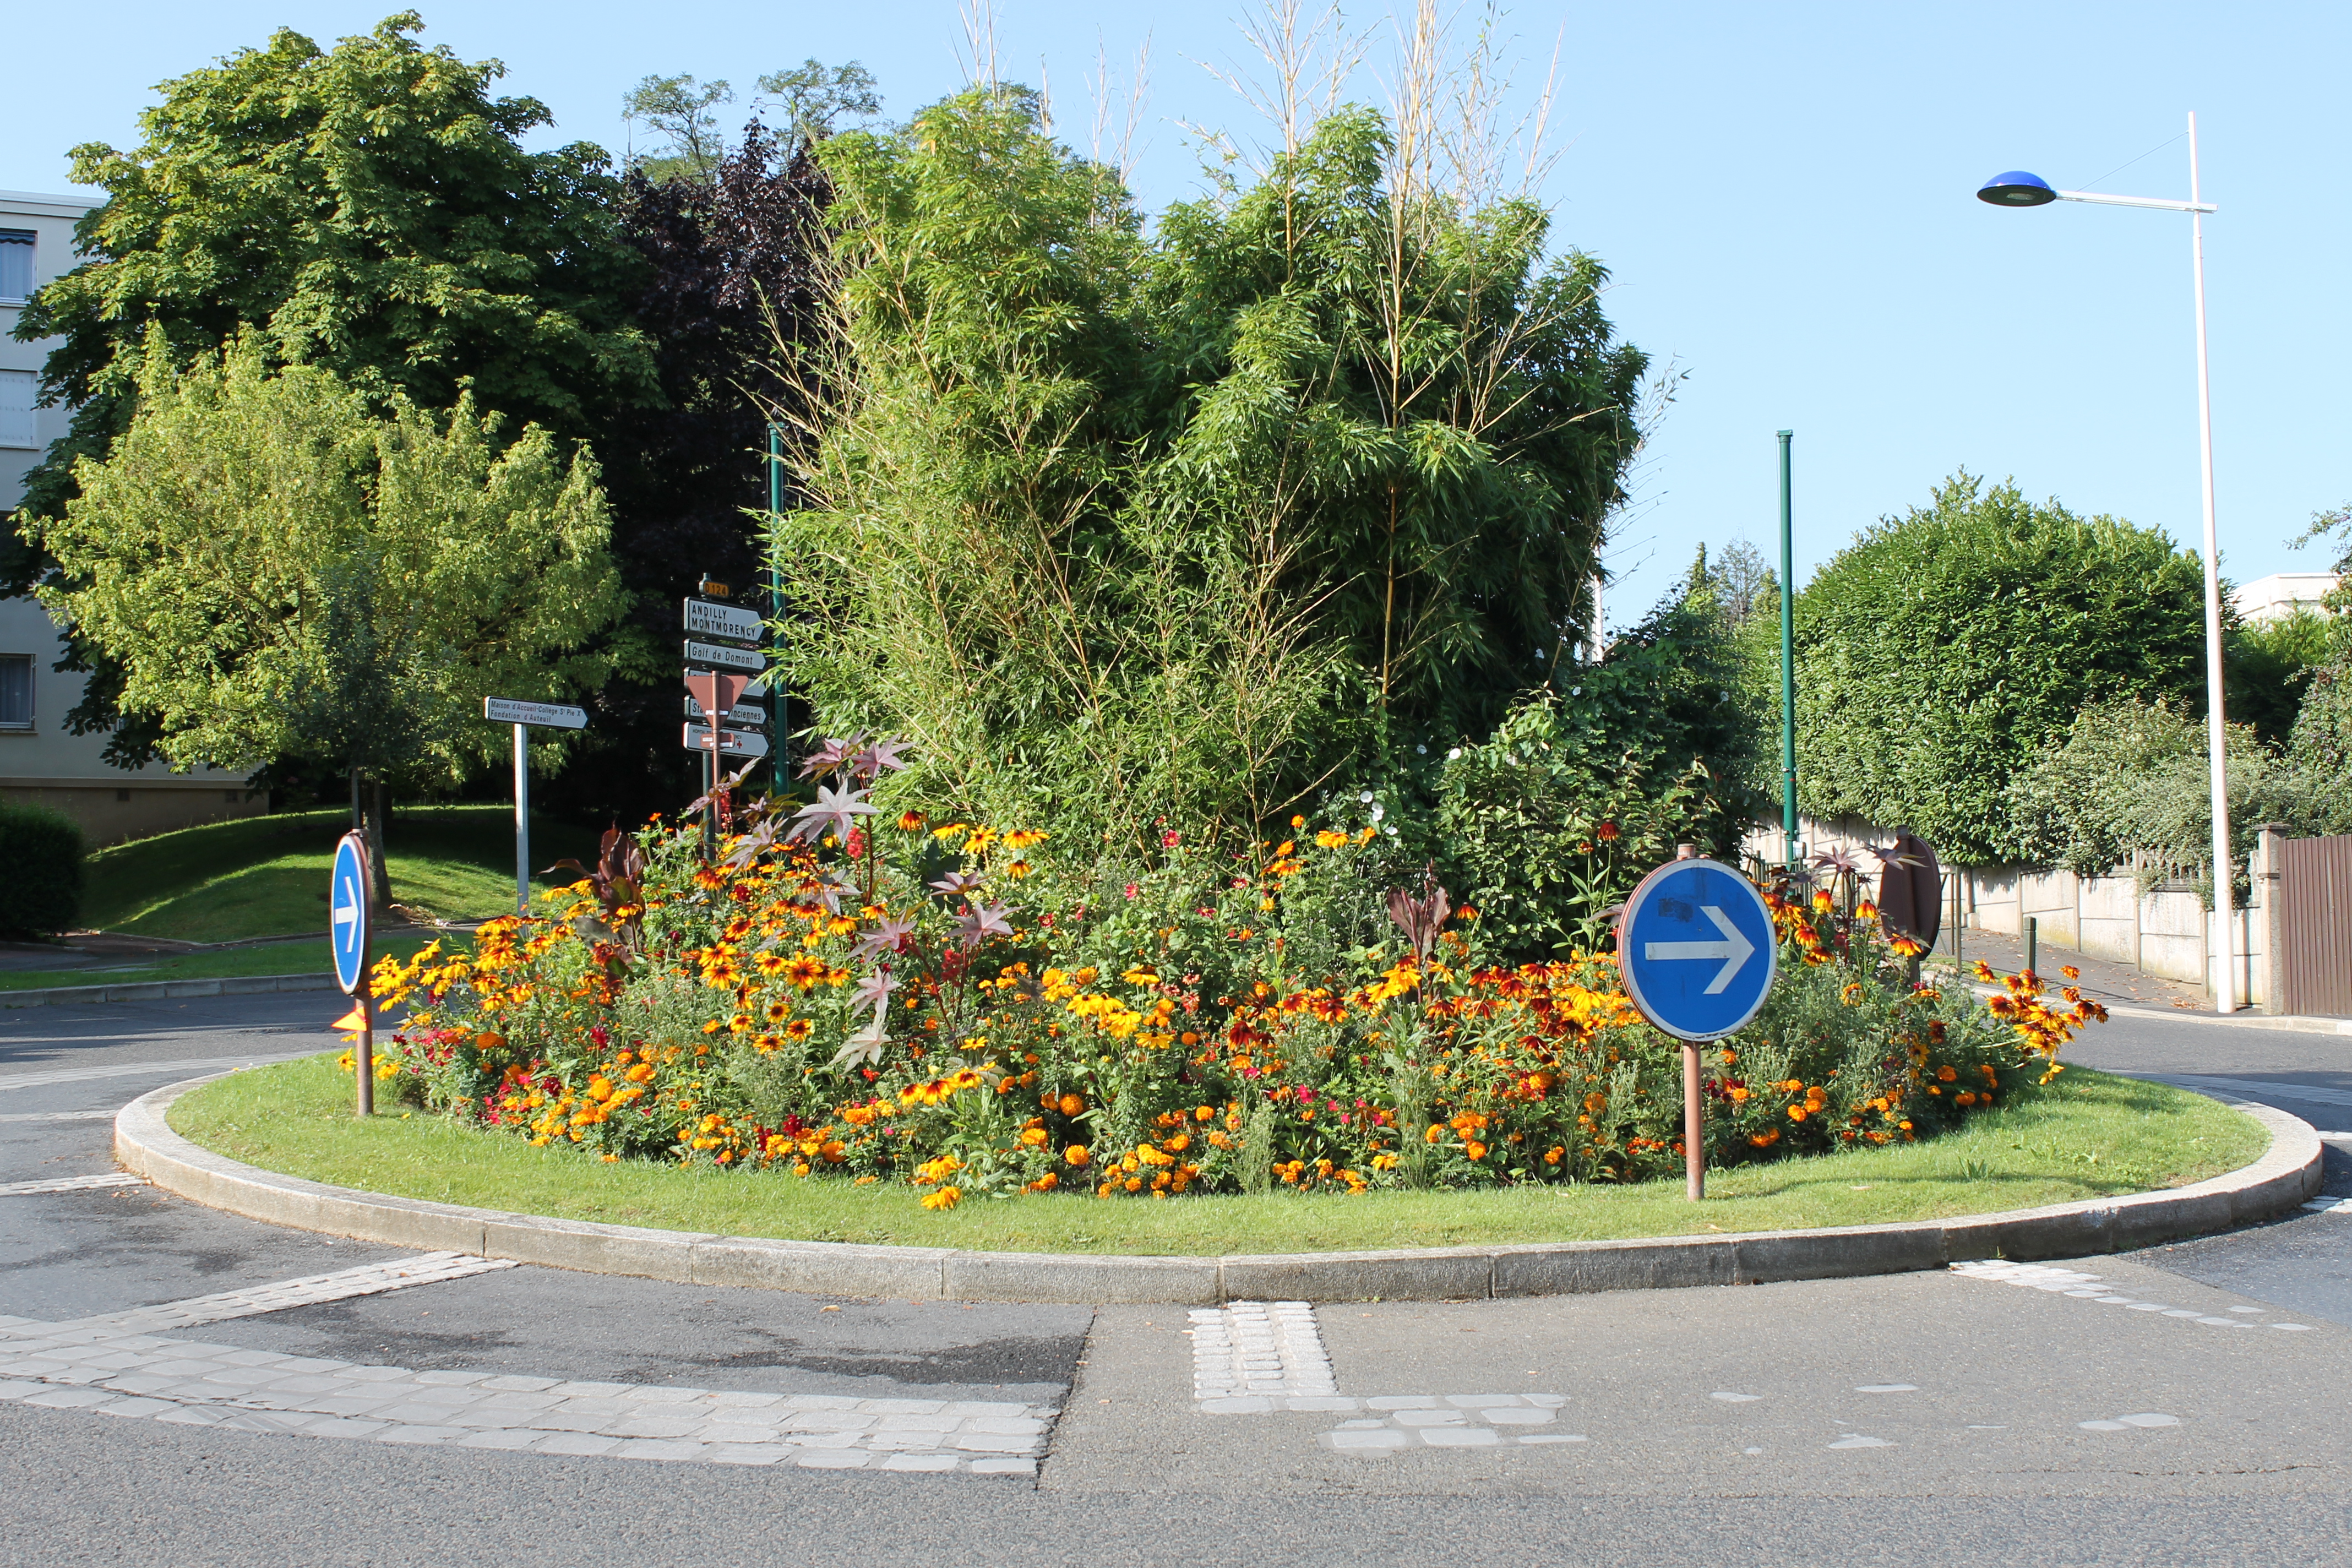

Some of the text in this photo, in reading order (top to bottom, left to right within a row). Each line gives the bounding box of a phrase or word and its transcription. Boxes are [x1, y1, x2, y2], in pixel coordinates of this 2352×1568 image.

[705, 583, 726, 595] D 124
[692, 604, 727, 619] ANDILLY
[692, 617, 756, 636] MONTMORENCY
[692, 646, 753, 665] Golf de Domont
[491, 701, 510, 709] Maison
[491, 710, 520, 719] Fondation
[731, 708, 761, 720] inciennes
